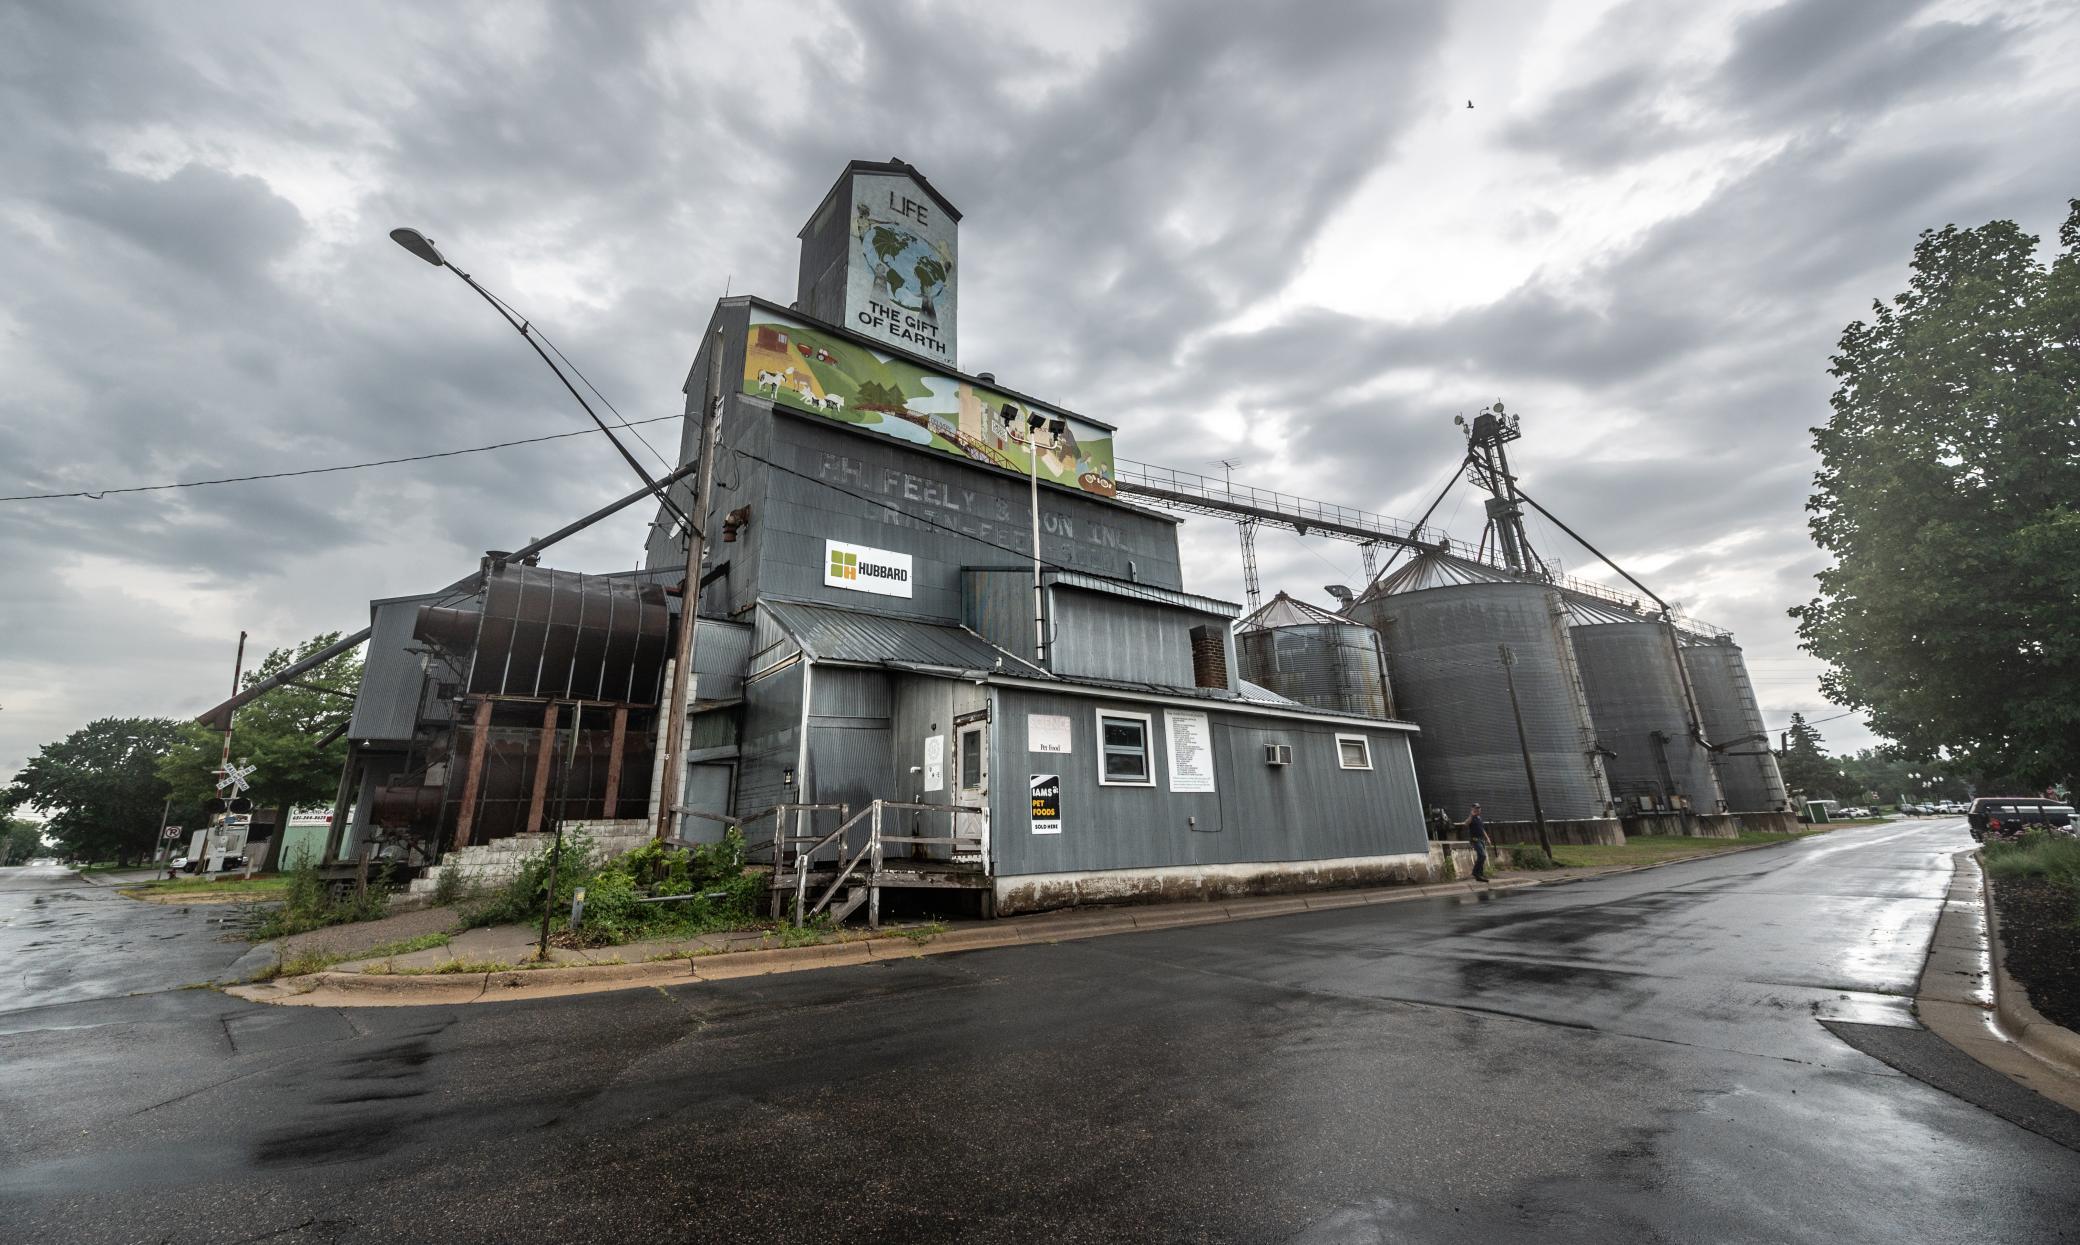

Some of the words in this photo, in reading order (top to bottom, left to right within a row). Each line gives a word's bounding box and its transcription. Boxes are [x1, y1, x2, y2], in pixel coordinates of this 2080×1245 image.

[889, 191, 928, 227] LIFE
[858, 311, 884, 332] OF
[889, 323, 946, 354] EARTH
[869, 300, 900, 323] THE
[905, 315, 939, 337] GIFT
[884, 467, 977, 513] FEELY
[858, 561, 908, 582] HUBBARD
[1032, 788, 1053, 797] IAMS
[1032, 799, 1045, 807] PET
[1032, 808, 1056, 816] FOODS
